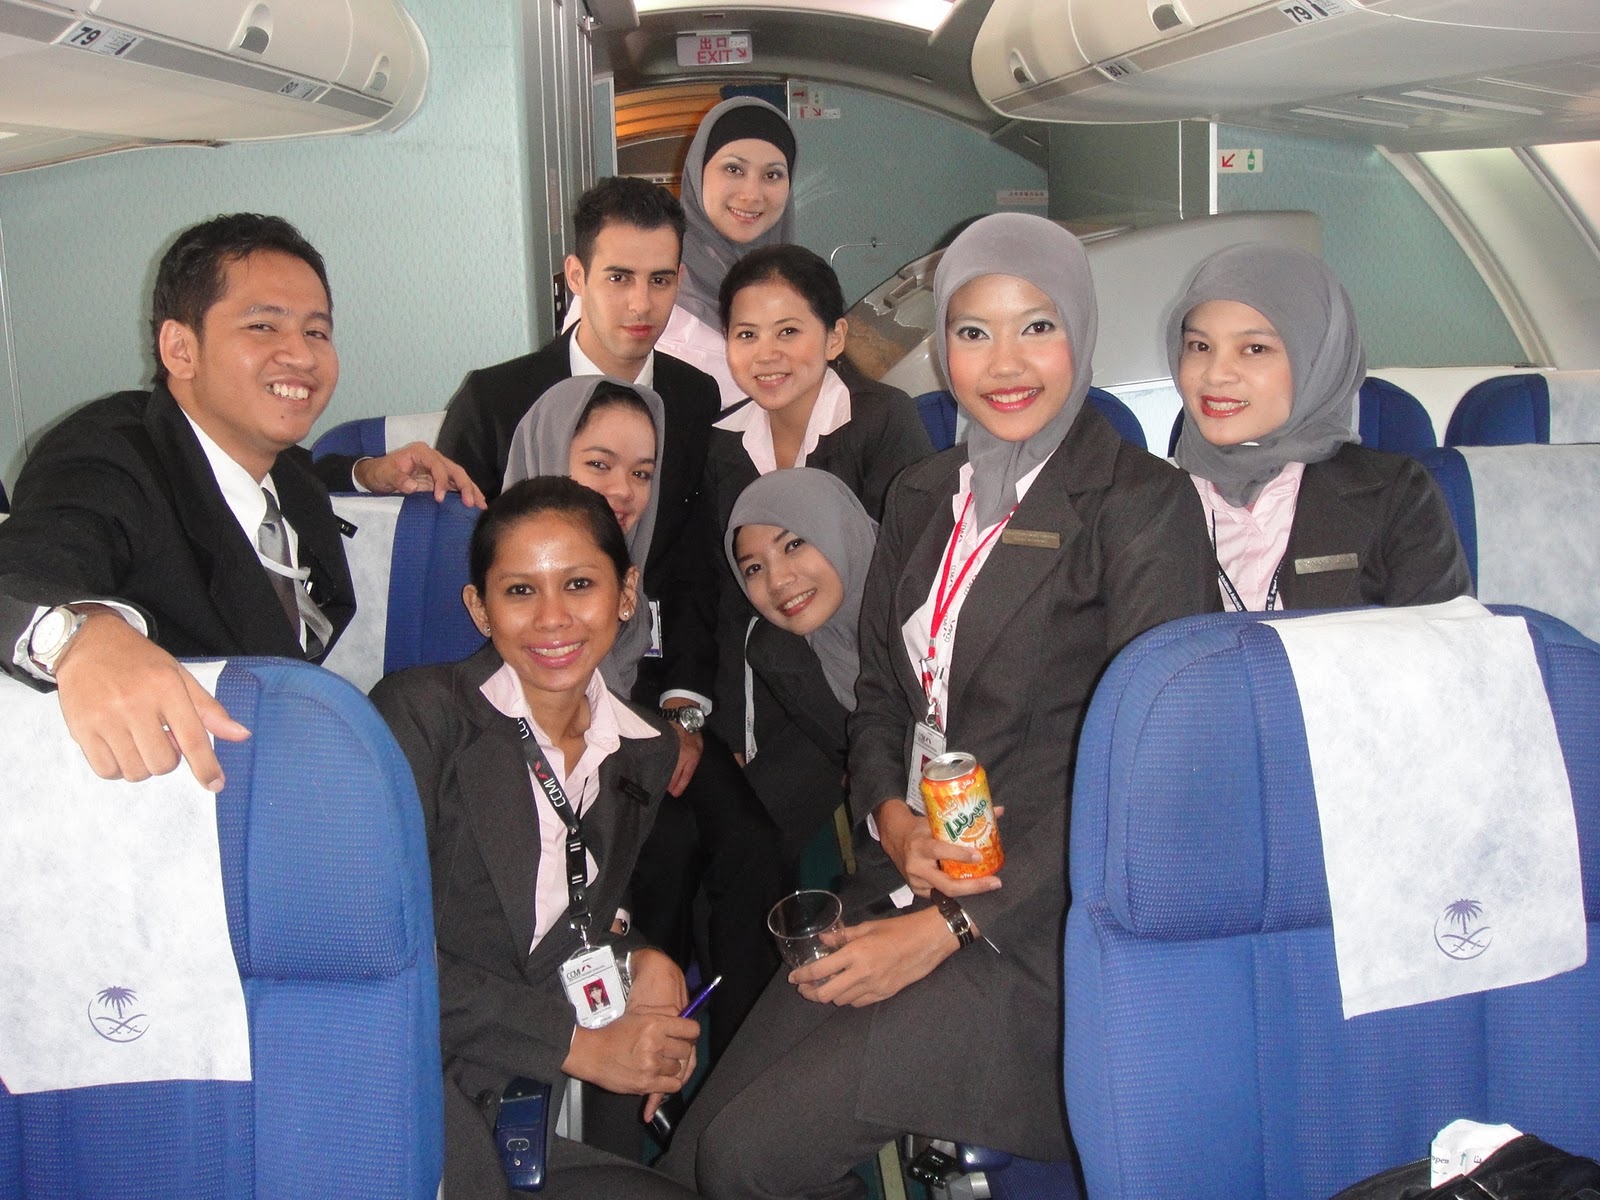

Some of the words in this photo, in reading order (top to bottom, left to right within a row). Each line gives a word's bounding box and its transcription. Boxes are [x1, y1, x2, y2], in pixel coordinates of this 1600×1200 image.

[1283, 6, 1312, 22] 79
[71, 26, 101, 45] 79
[700, 37, 727, 50] 出口
[697, 50, 732, 64] EXIT
[543, 777, 566, 807] CCMI
